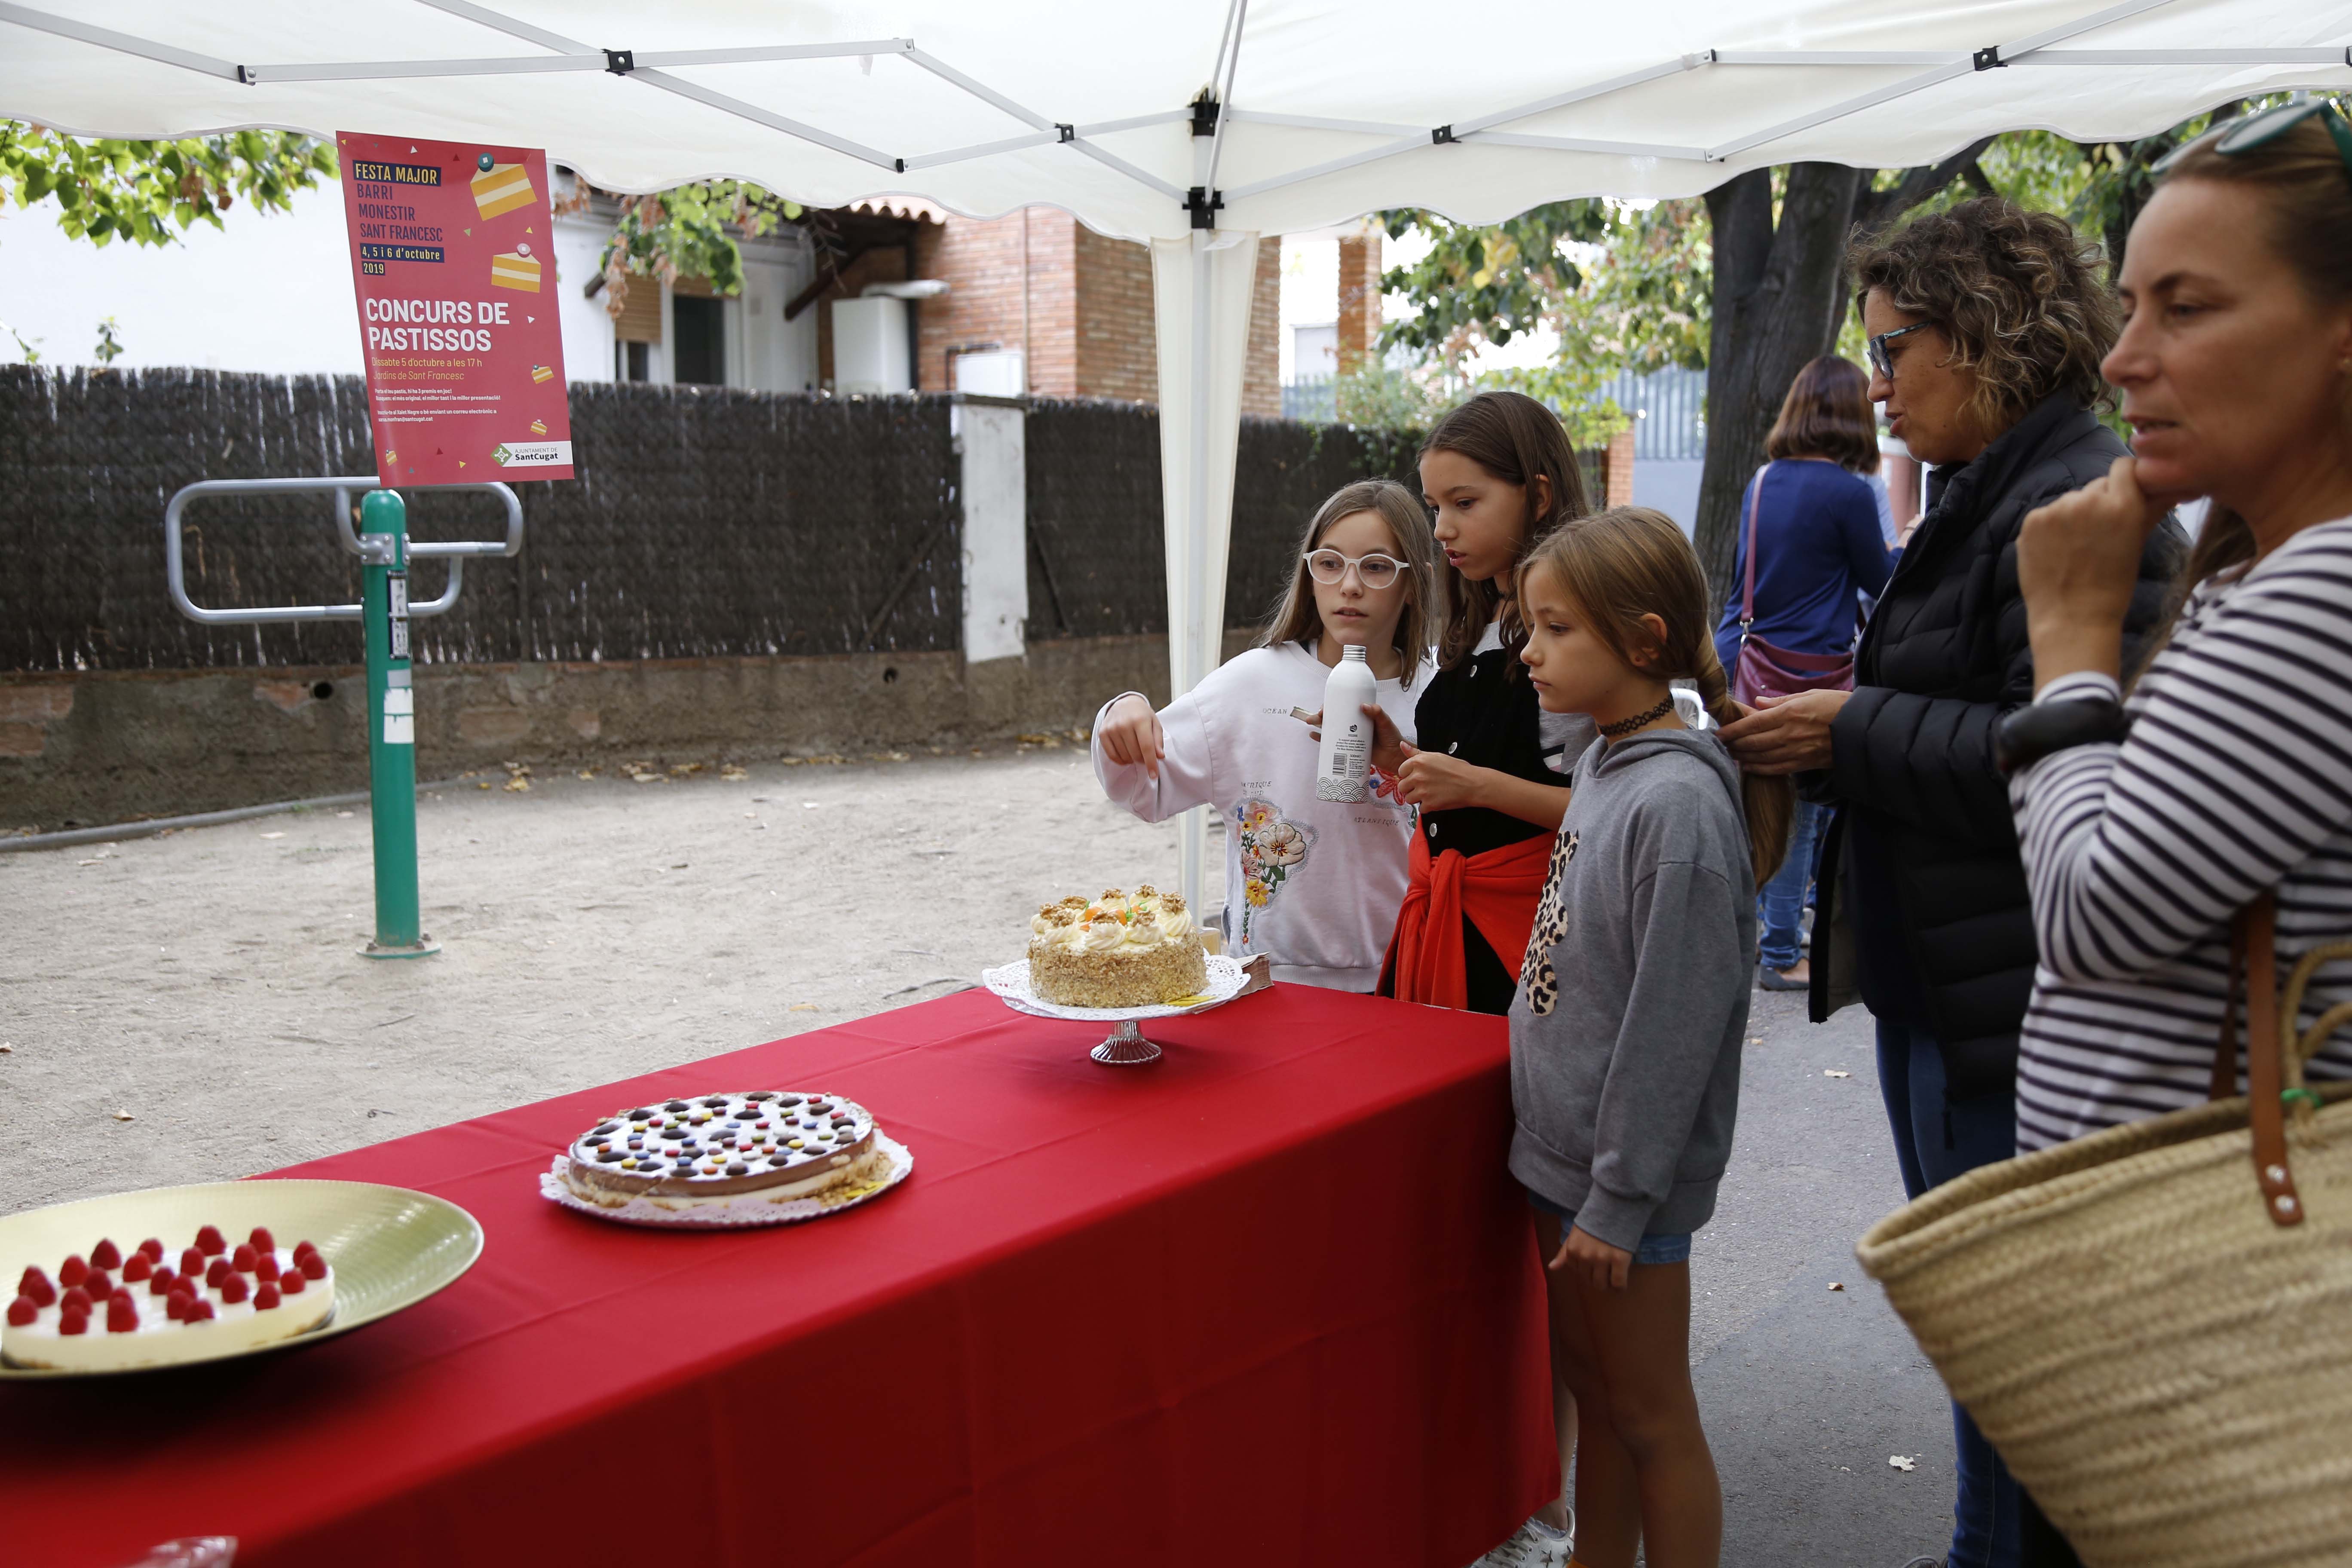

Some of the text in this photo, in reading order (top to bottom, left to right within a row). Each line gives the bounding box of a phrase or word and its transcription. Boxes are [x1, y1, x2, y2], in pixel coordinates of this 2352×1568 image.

[355, 163, 437, 184] FESTA MAJOR
[357, 184, 392, 199] BARRI
[358, 203, 415, 221] MONESTIR
[360, 223, 443, 242] SANT FRANCESC
[362, 246, 440, 260] 4, 5 i 6 d'octubre
[364, 263, 384, 274] 2019
[366, 298, 510, 325] CONCURS DE
[368, 327, 491, 352] PASTISSOS
[372, 357, 400, 366] Dissabte
[401, 358, 406, 366] 5
[408, 358, 444, 367] d'octubre
[453, 358, 465, 367] les
[468, 358, 475, 367] 17
[477, 358, 482, 367] h
[374, 371, 464, 380] Jardins de Sant Francesc
